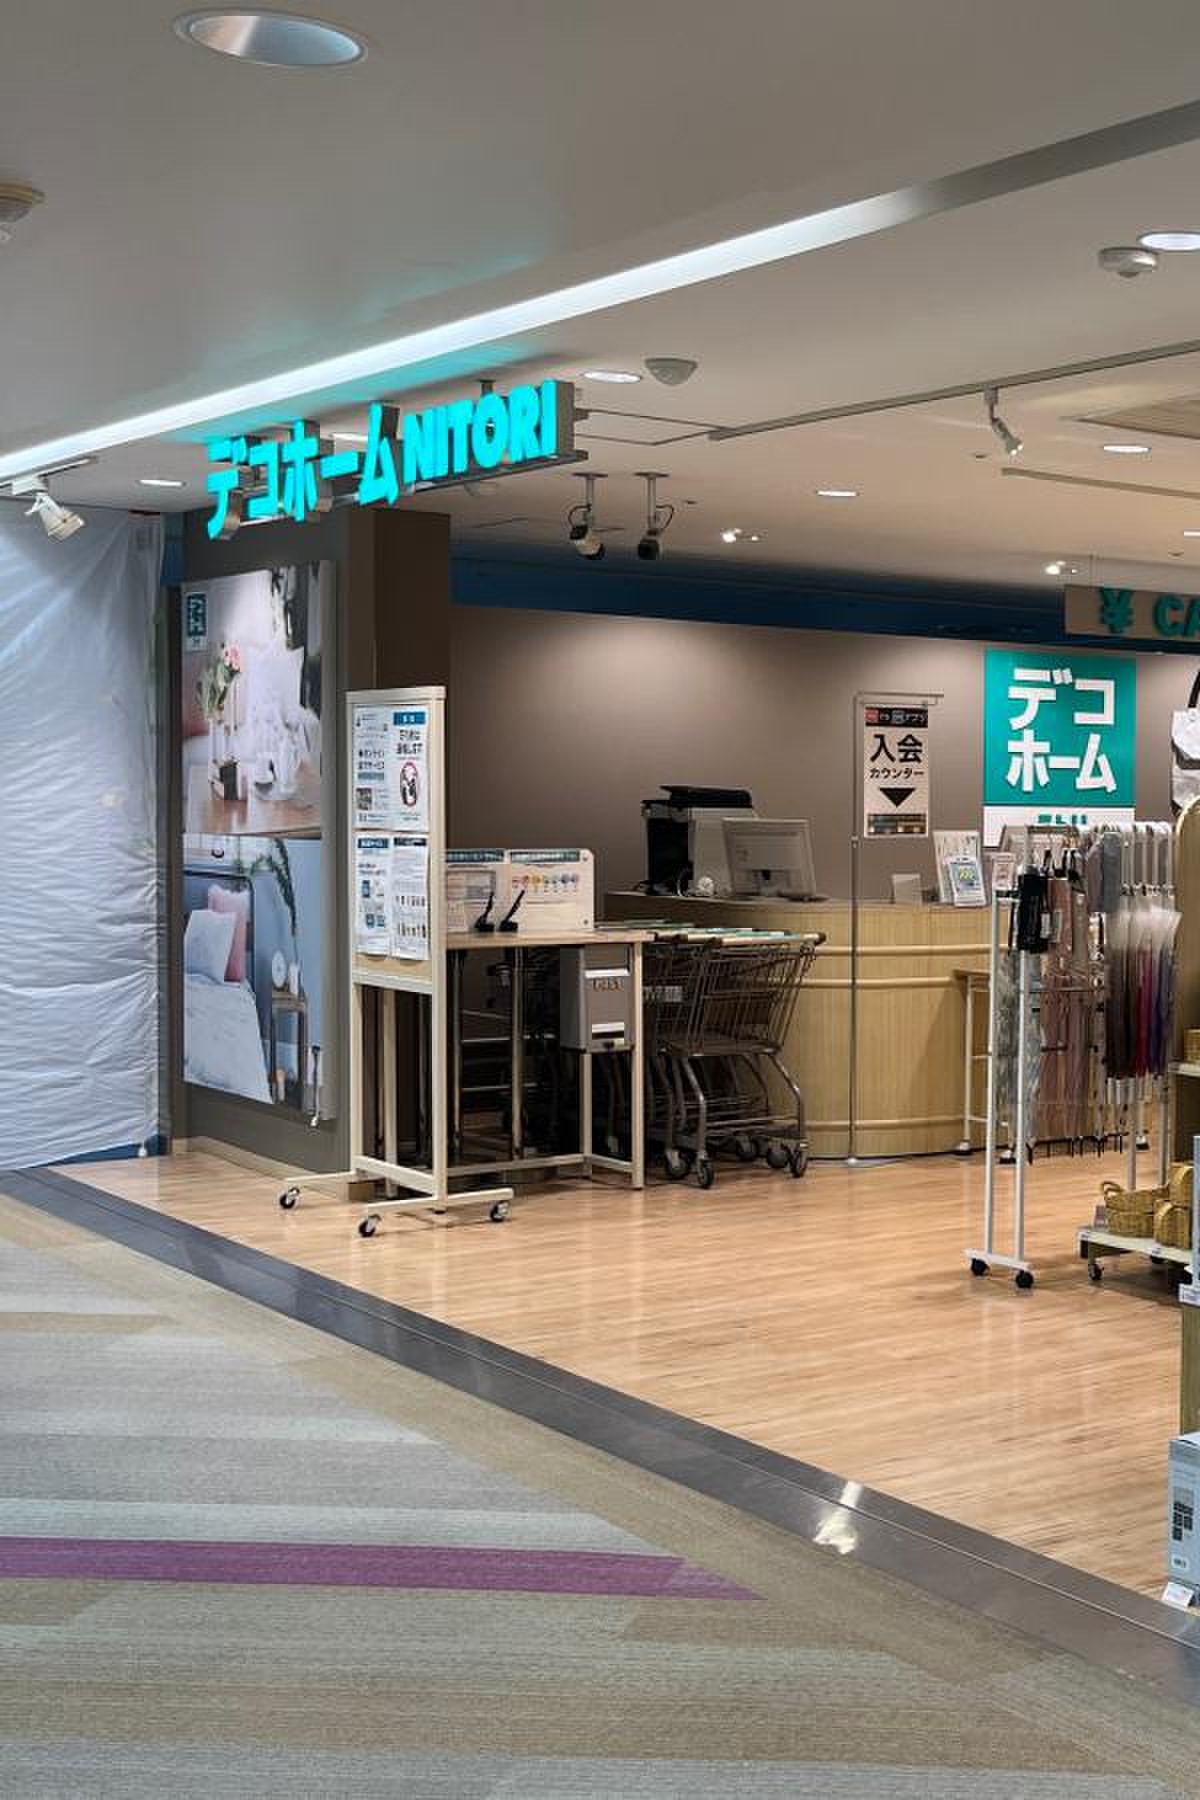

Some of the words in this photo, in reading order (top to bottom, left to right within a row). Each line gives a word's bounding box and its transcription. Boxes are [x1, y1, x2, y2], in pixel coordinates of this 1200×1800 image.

[207, 404, 399, 540] デコホーム
[402, 379, 558, 484] NITORI
[1007, 667, 1115, 730] デコ
[869, 767, 925, 779] カウンター
[870, 733, 923, 763] 入会
[1006, 730, 1118, 793] ホーム
